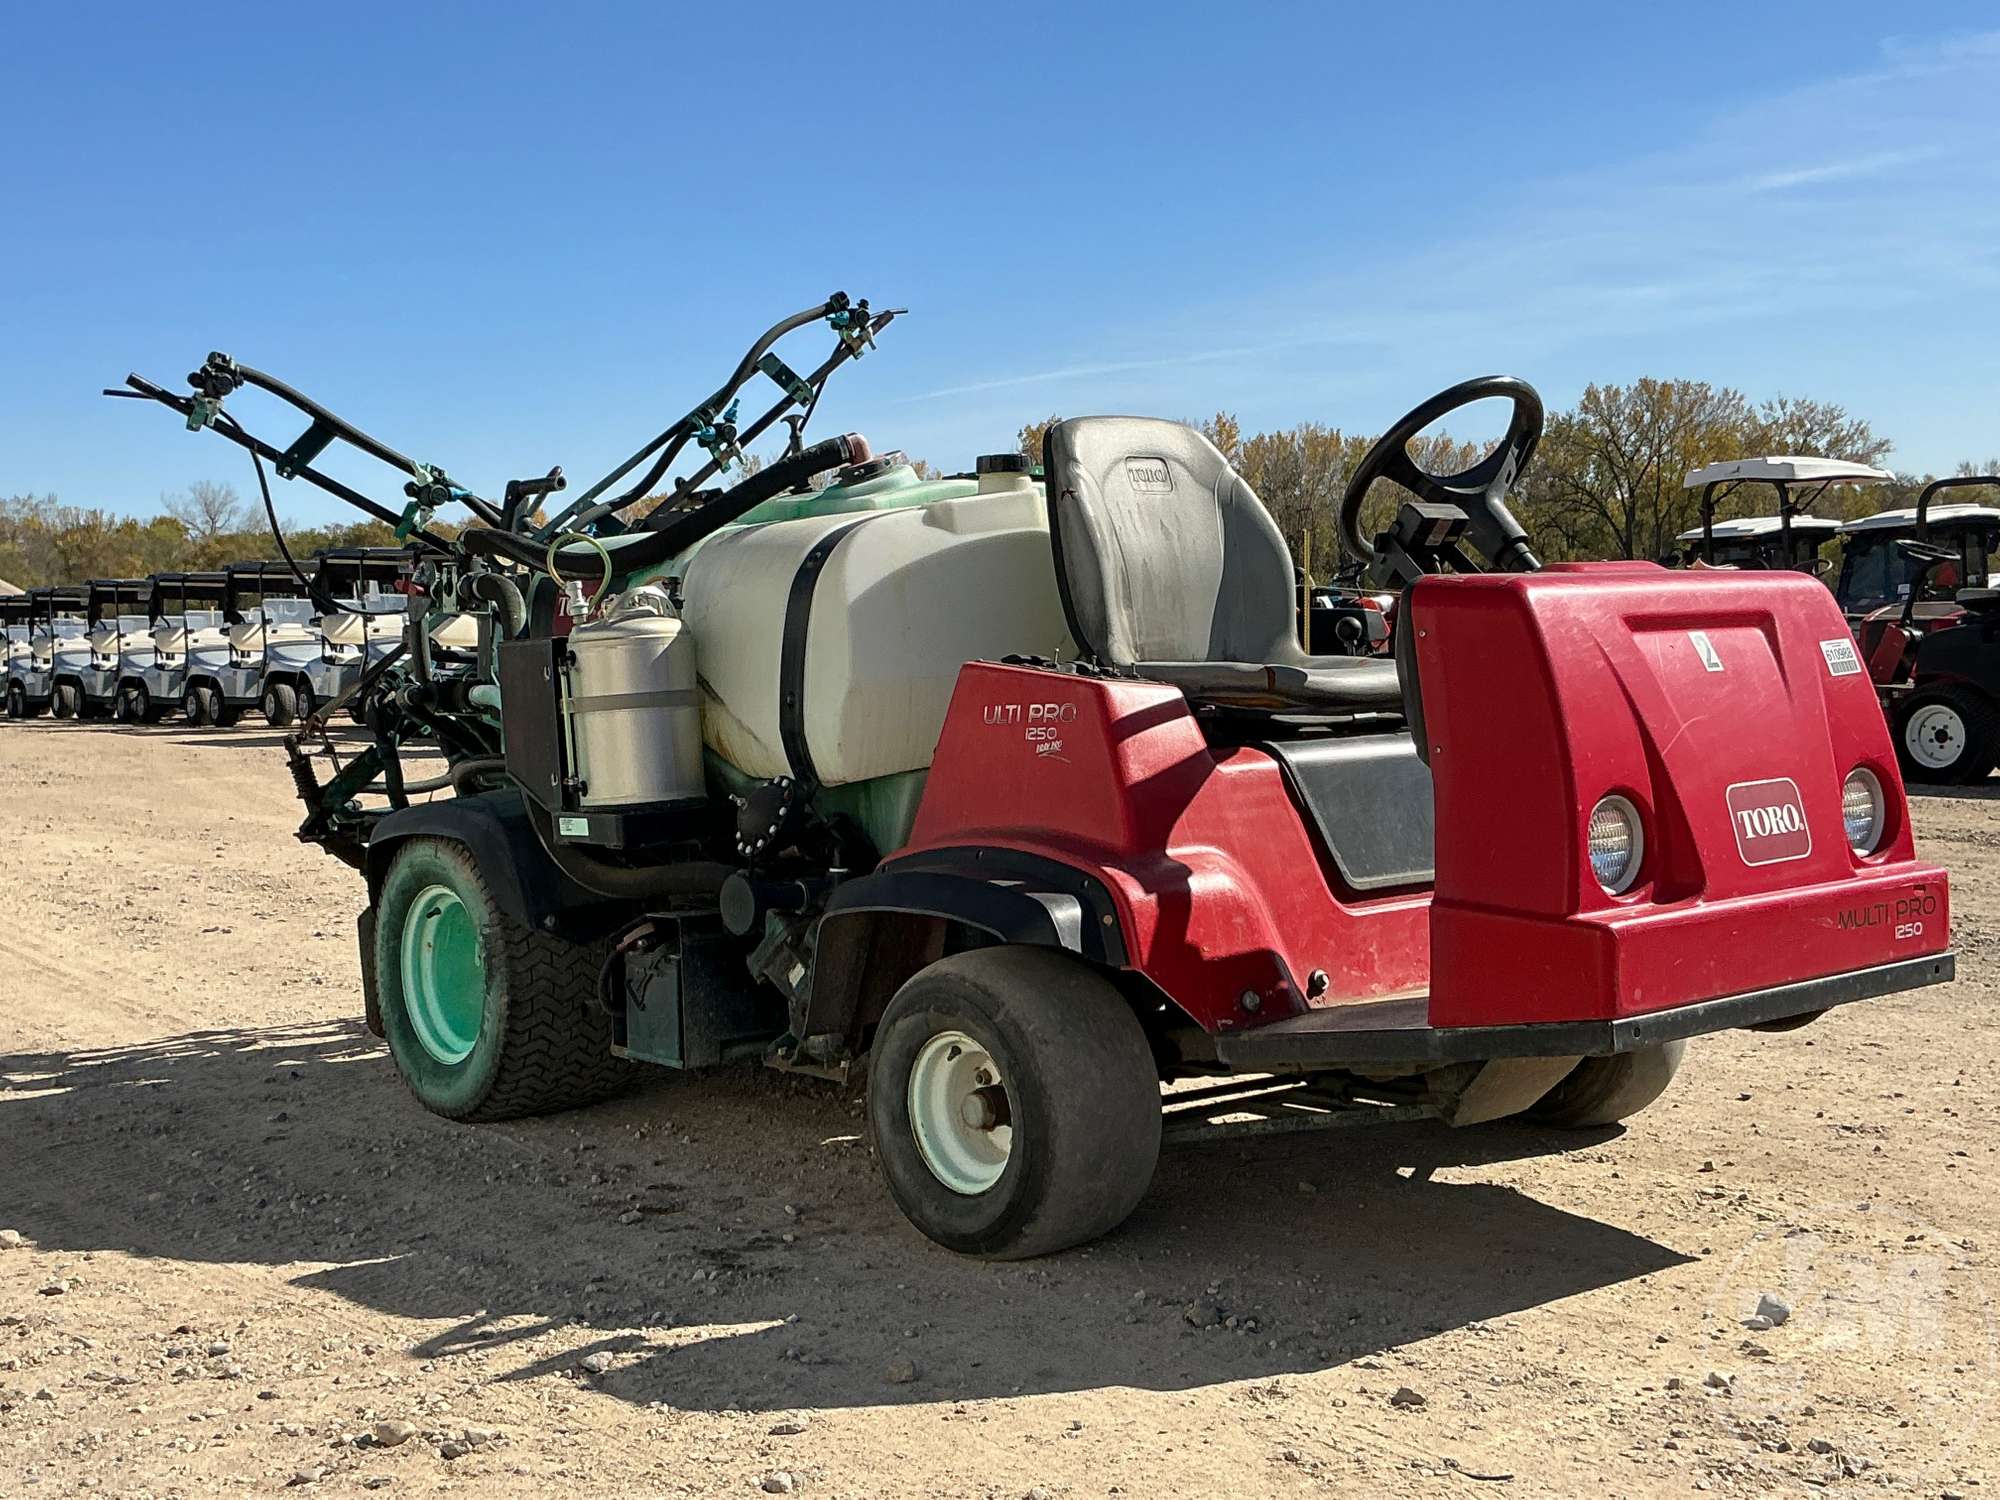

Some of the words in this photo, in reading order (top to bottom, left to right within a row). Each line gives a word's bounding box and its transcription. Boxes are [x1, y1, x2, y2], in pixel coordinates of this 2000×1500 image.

[1693, 634, 1721, 668] 2
[1028, 703, 1077, 723] PRO
[1025, 727, 1058, 741] 1250
[1838, 904, 1889, 929] MULTI
[1895, 896, 1936, 920] PRO
